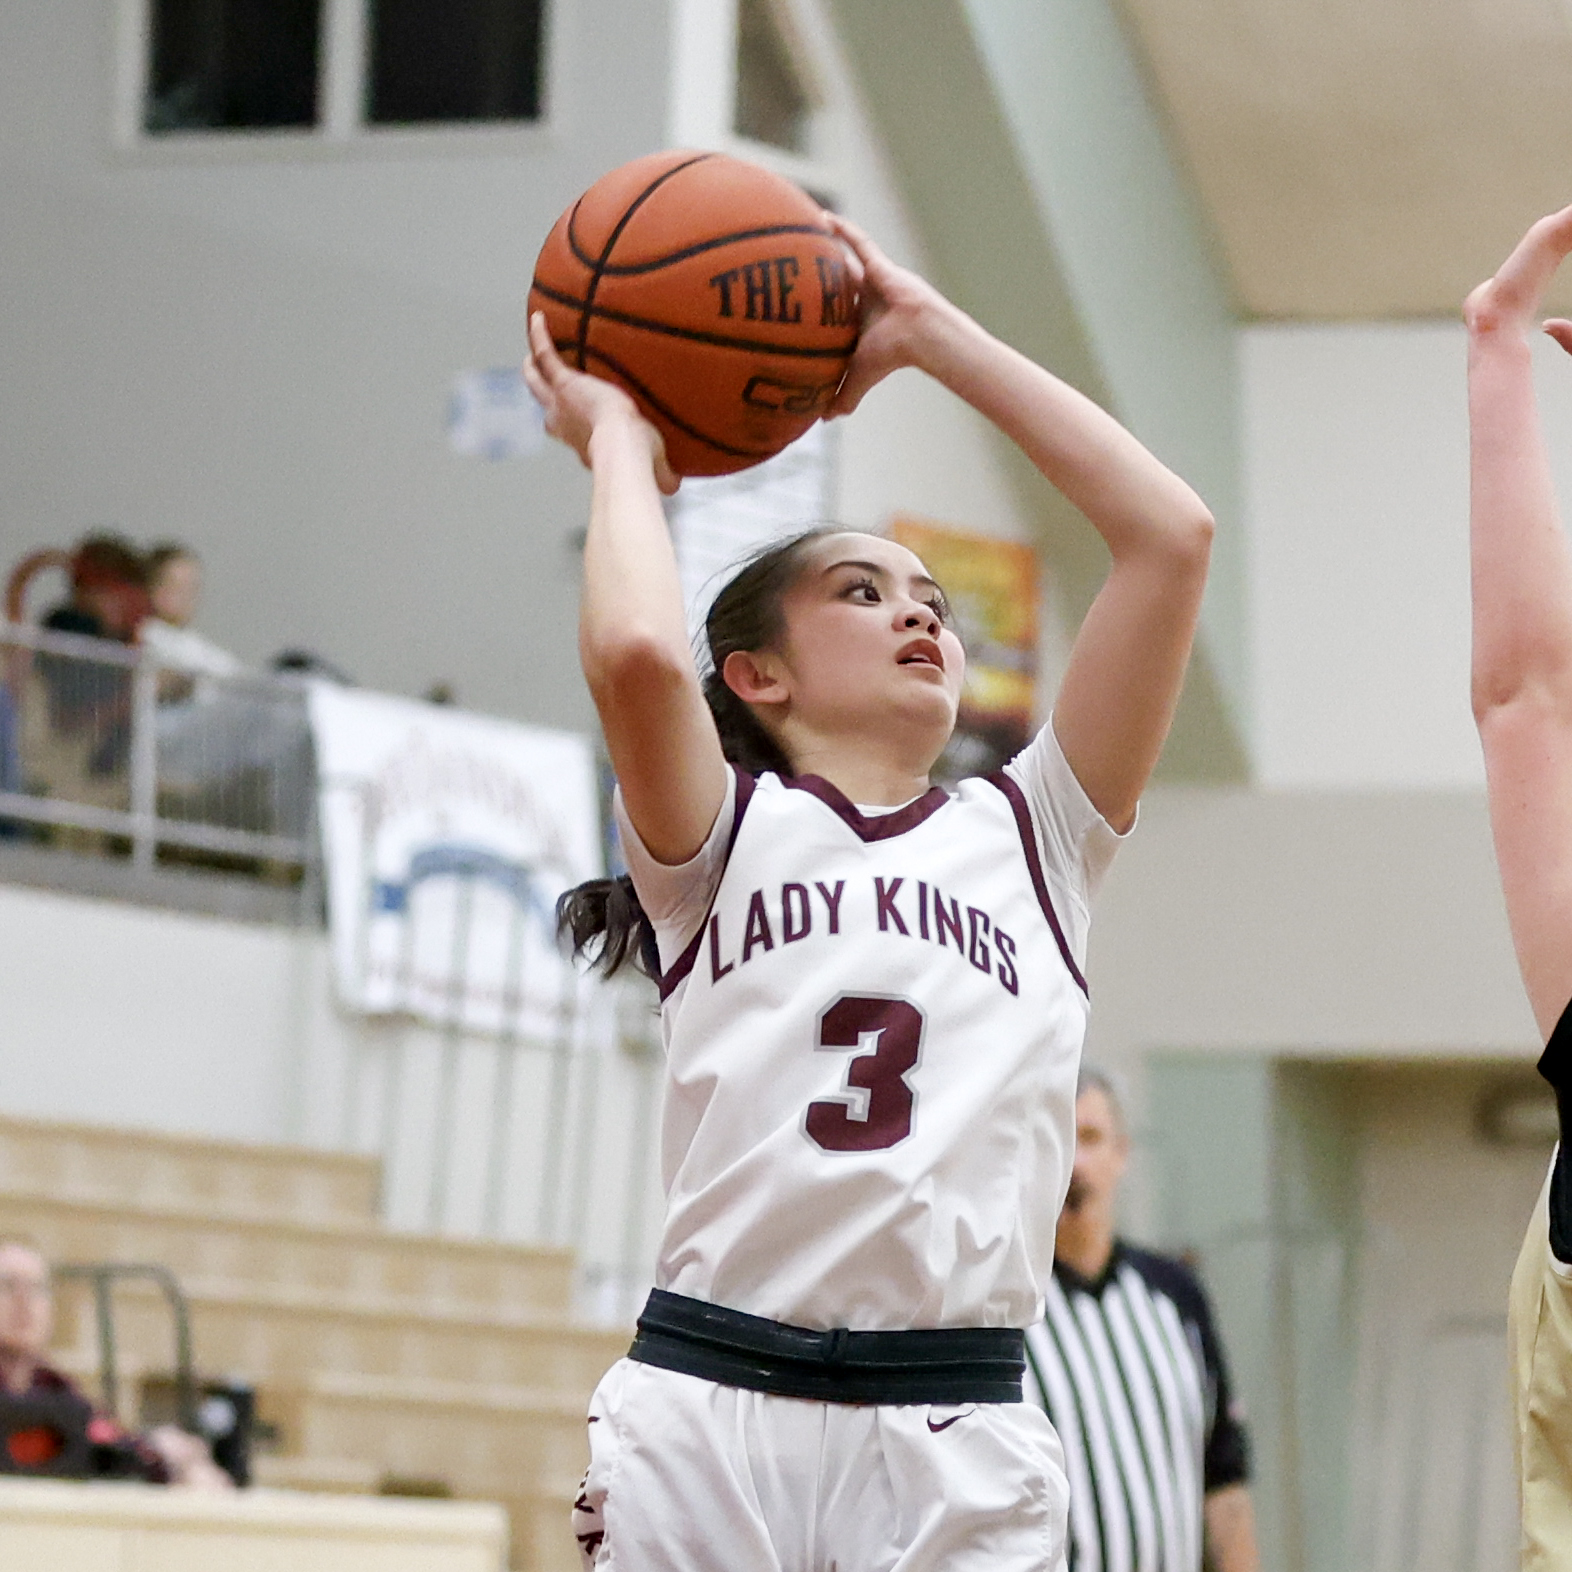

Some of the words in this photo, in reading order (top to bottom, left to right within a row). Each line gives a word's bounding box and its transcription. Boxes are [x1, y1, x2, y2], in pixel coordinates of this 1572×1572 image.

[709, 255, 802, 325] THE
[709, 878, 847, 987] LADY
[872, 876, 1020, 998] KINGS
[798, 989, 929, 1158] 3
